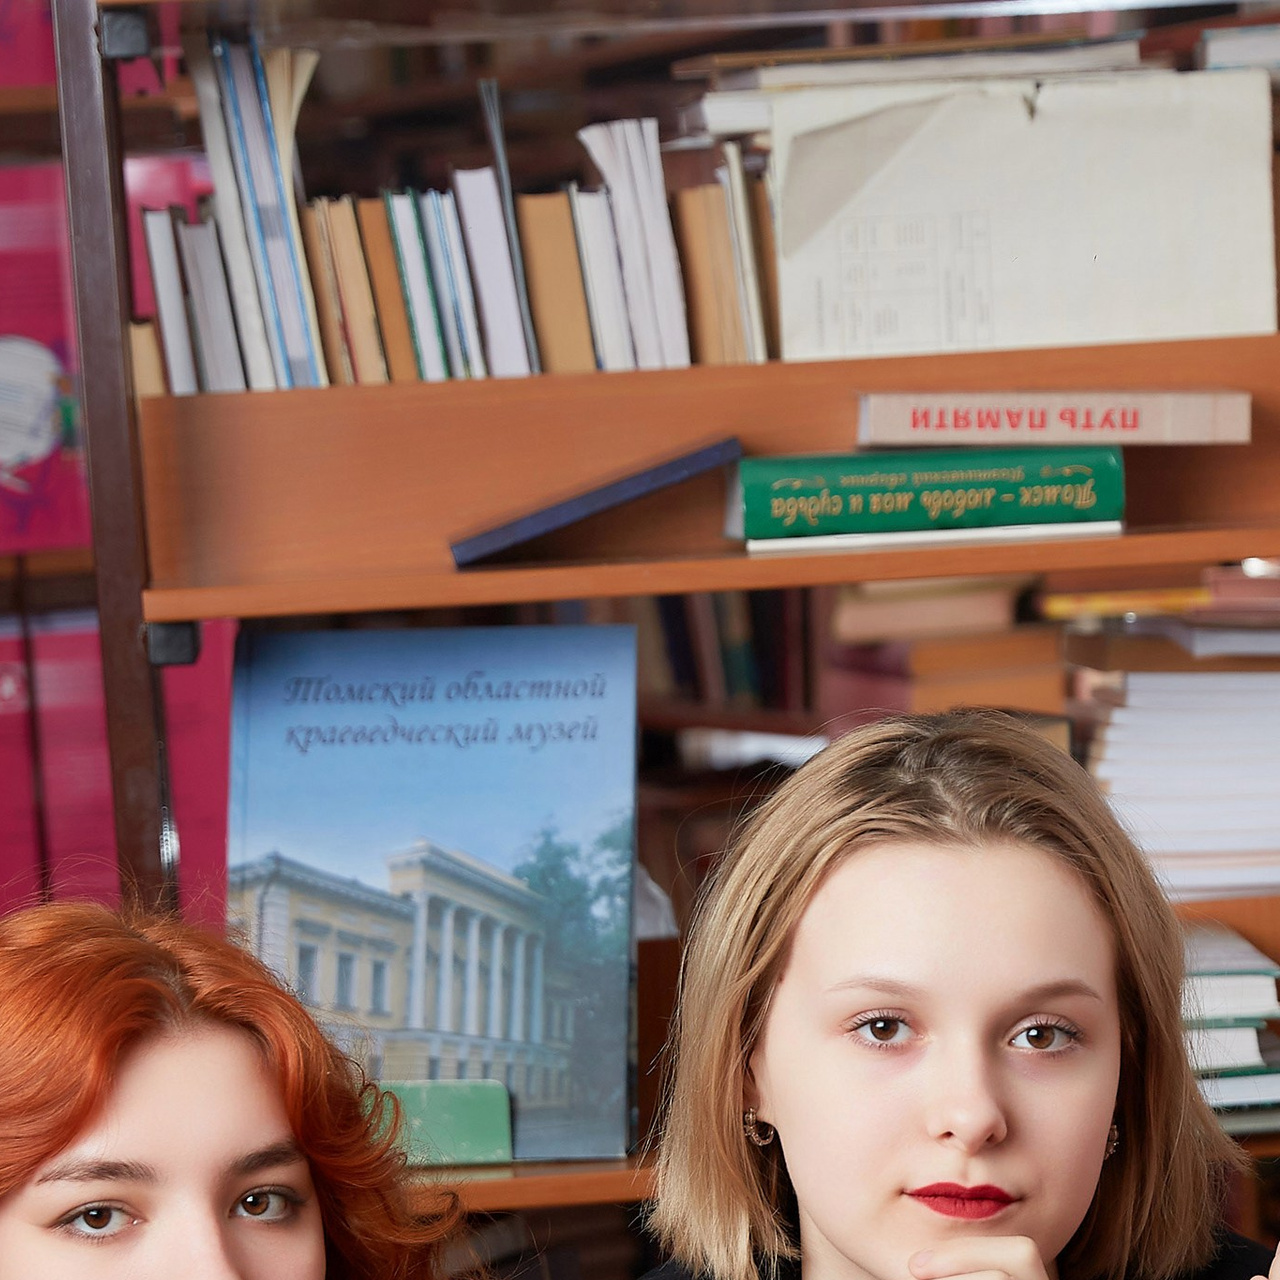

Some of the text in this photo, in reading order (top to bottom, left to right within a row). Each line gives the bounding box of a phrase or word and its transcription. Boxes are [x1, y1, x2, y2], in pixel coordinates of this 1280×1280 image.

[911, 406, 1139, 431] ПУТЬ ПАМЯТИ
[771, 488, 843, 526] судьба
[849, 494, 863, 515] и
[868, 491, 914, 515] моя
[920, 487, 997, 519] любовь
[1019, 479, 1098, 509] Томск
[284, 670, 607, 708] Томский областной
[285, 714, 599, 754] краеведческий музей
